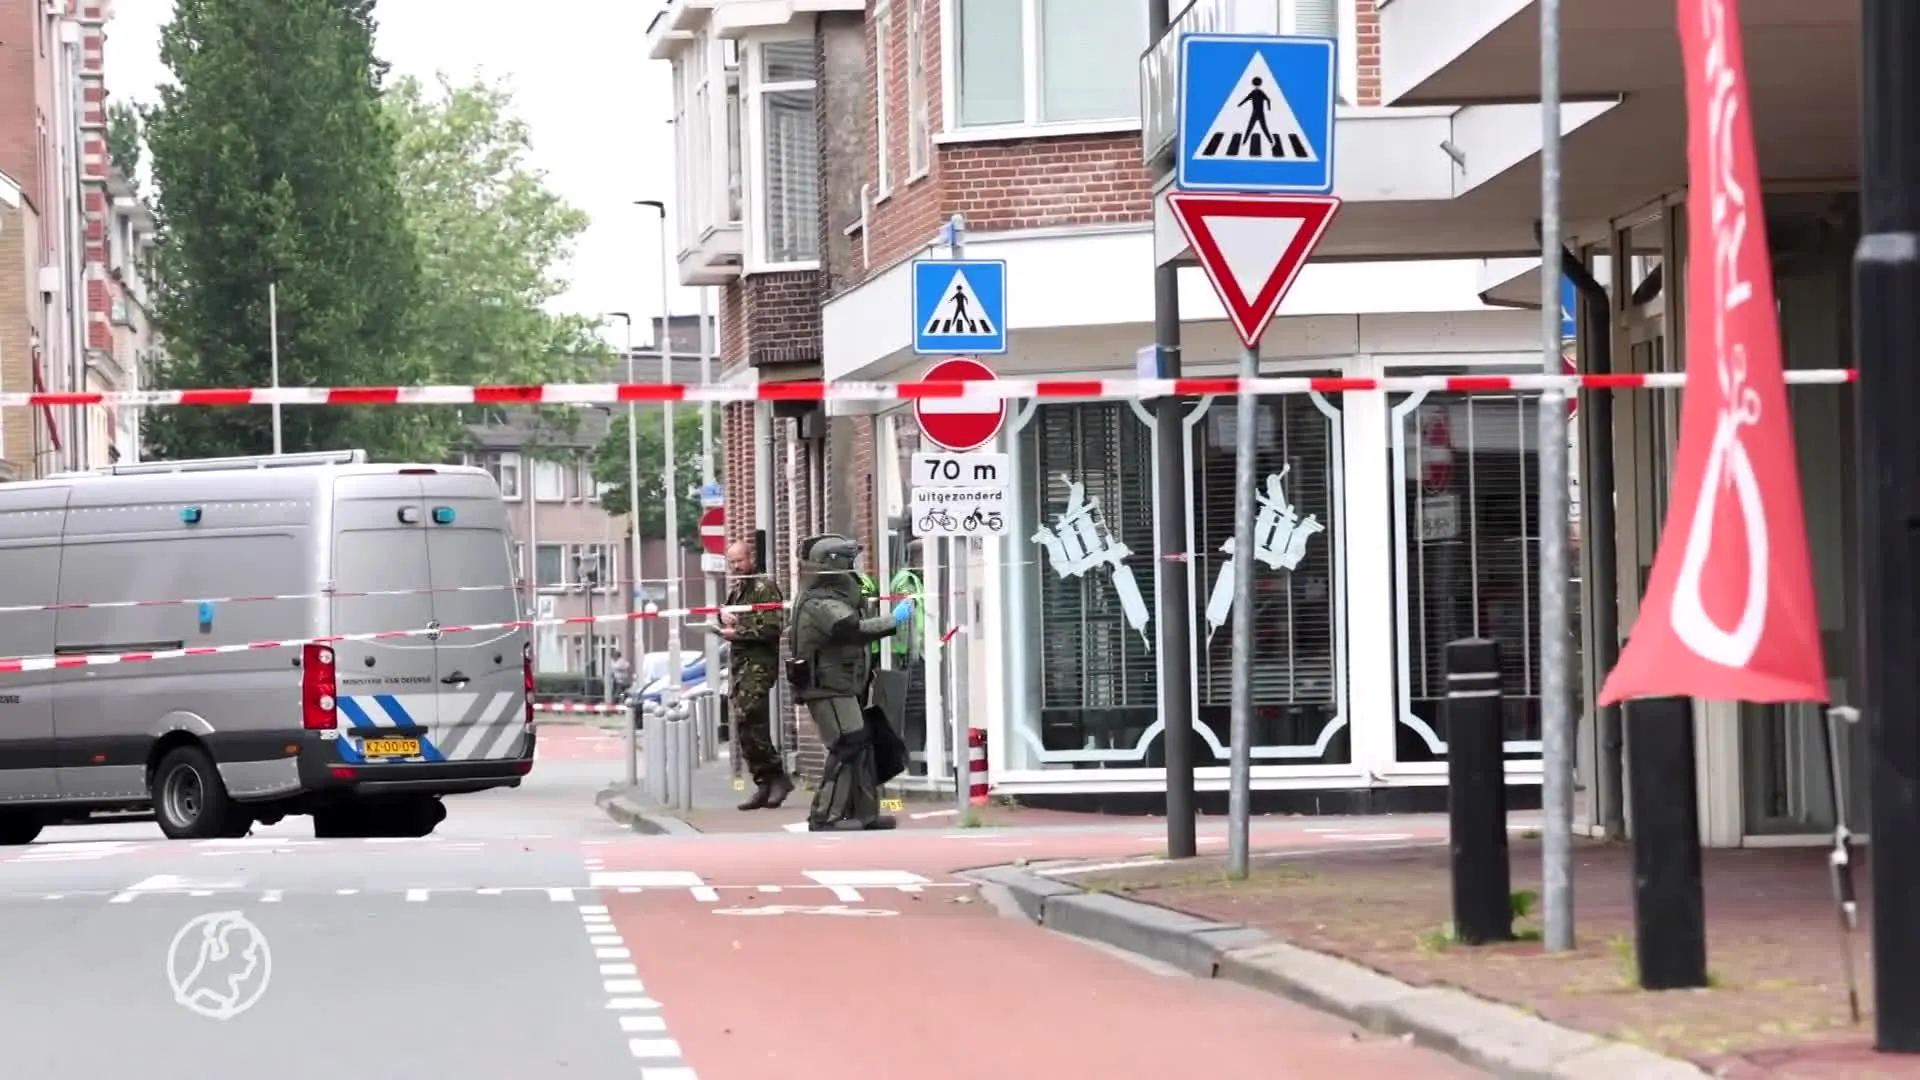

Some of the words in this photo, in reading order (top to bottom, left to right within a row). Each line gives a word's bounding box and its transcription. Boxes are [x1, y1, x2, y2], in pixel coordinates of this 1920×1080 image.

[924, 459, 960, 480] 70
[974, 464, 996, 480] m
[918, 491, 1002, 504] uitgezonderd
